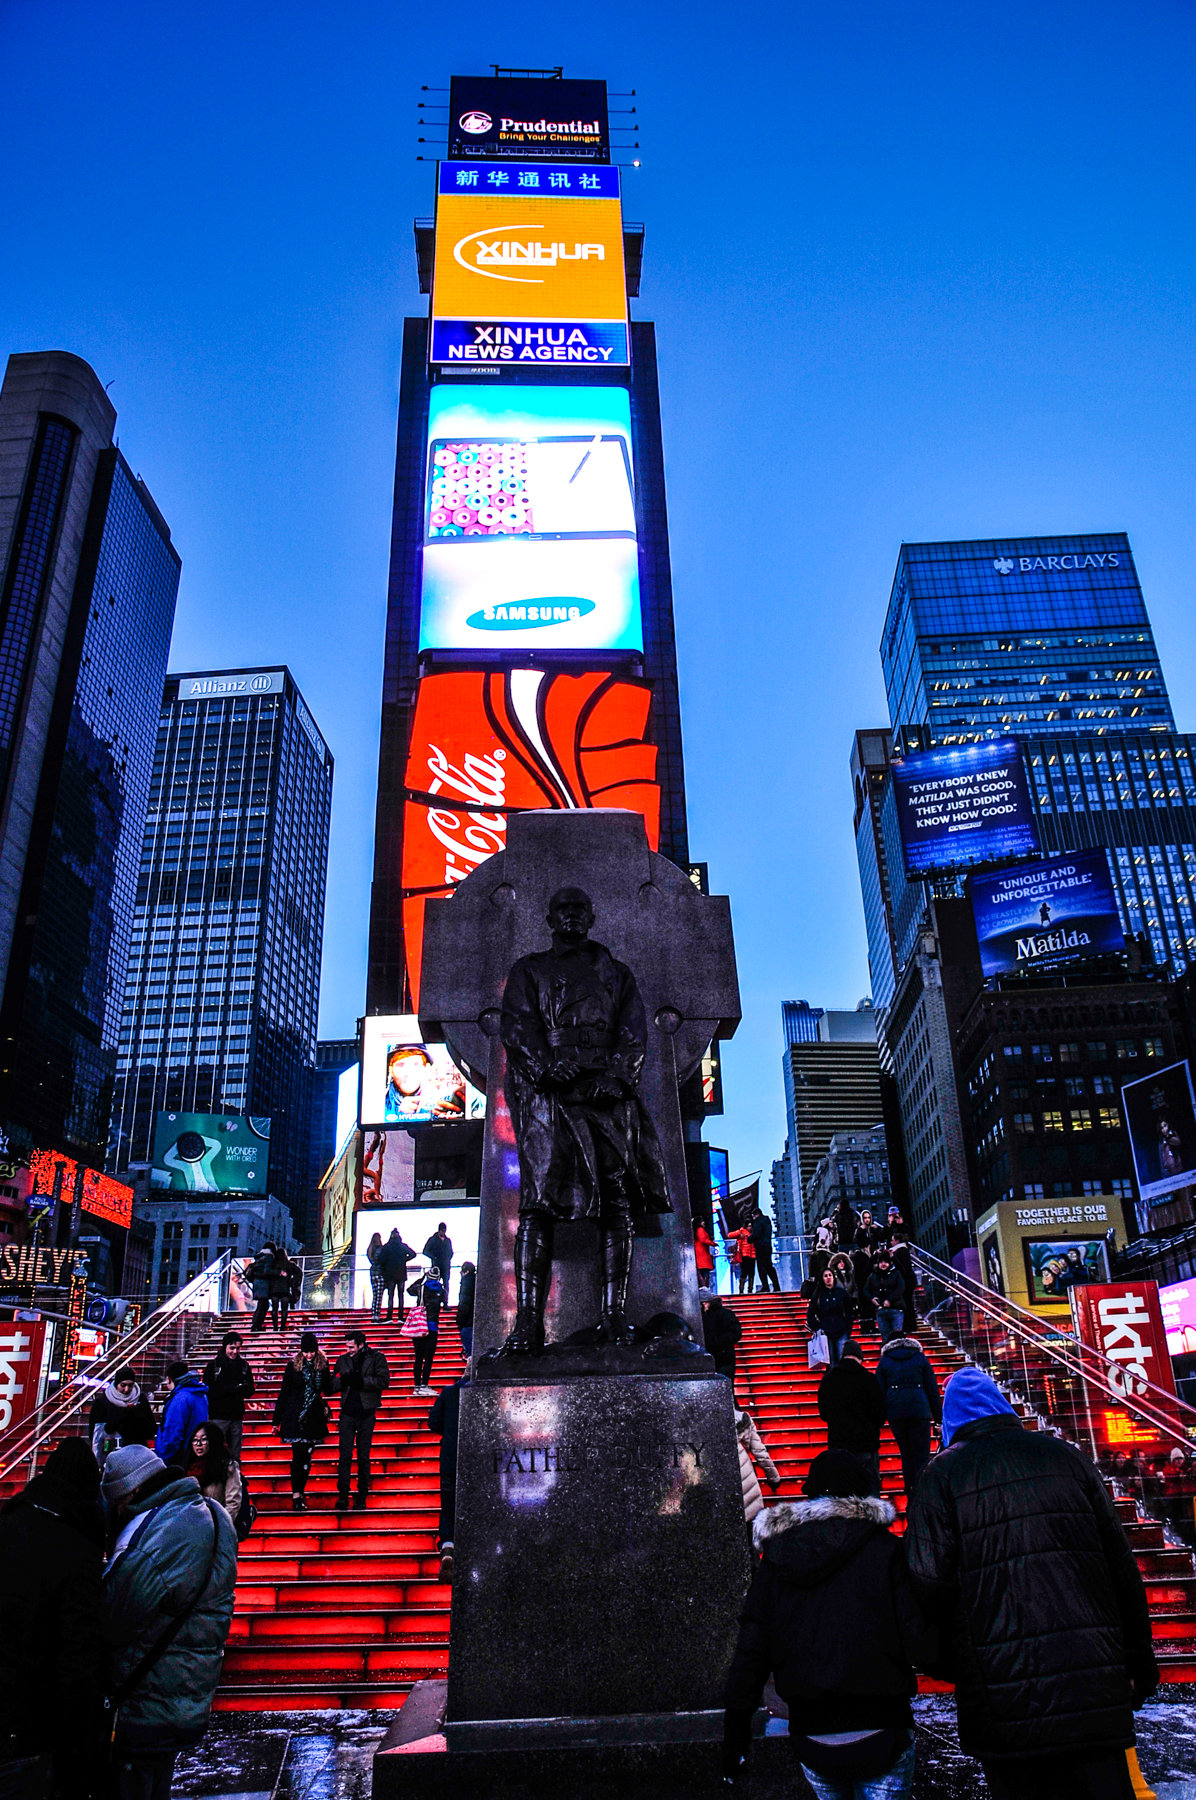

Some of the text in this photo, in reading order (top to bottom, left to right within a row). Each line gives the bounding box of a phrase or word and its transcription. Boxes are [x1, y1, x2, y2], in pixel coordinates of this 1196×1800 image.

[500, 118, 600, 134] Prudential
[499, 132, 601, 142] Bring Your Challenges
[456, 170, 601, 189] 新华通讯社
[476, 241, 605, 260] XINHUA
[474, 326, 588, 346] XINHUA
[448, 345, 613, 361] NEWS AGENCY
[1019, 553, 1119, 572] BARCLAYS
[483, 606, 581, 621] SAMSUNG
[189, 680, 248, 695] Allianz
[908, 769, 1009, 793] "EVERYBODY KNEW
[908, 780, 1017, 806] MATILDA WAS GOOD,
[915, 793, 1010, 816] THEY JUST DIDN'T
[916, 815, 950, 828] KNOW
[952, 810, 980, 821] HOW
[998, 871, 1047, 890] "UNIQUE
[1050, 865, 1077, 880] AND
[1014, 928, 1092, 961] Matilda
[226, 1146, 258, 1156] WONDER
[226, 1154, 258, 1163] WITH OREO
[1015, 1204, 1107, 1219] TOGETHER IS OUR
[1016, 1213, 1108, 1226] FAVORITE PLACE TO BE
[1098, 1292, 1153, 1398] tkts
